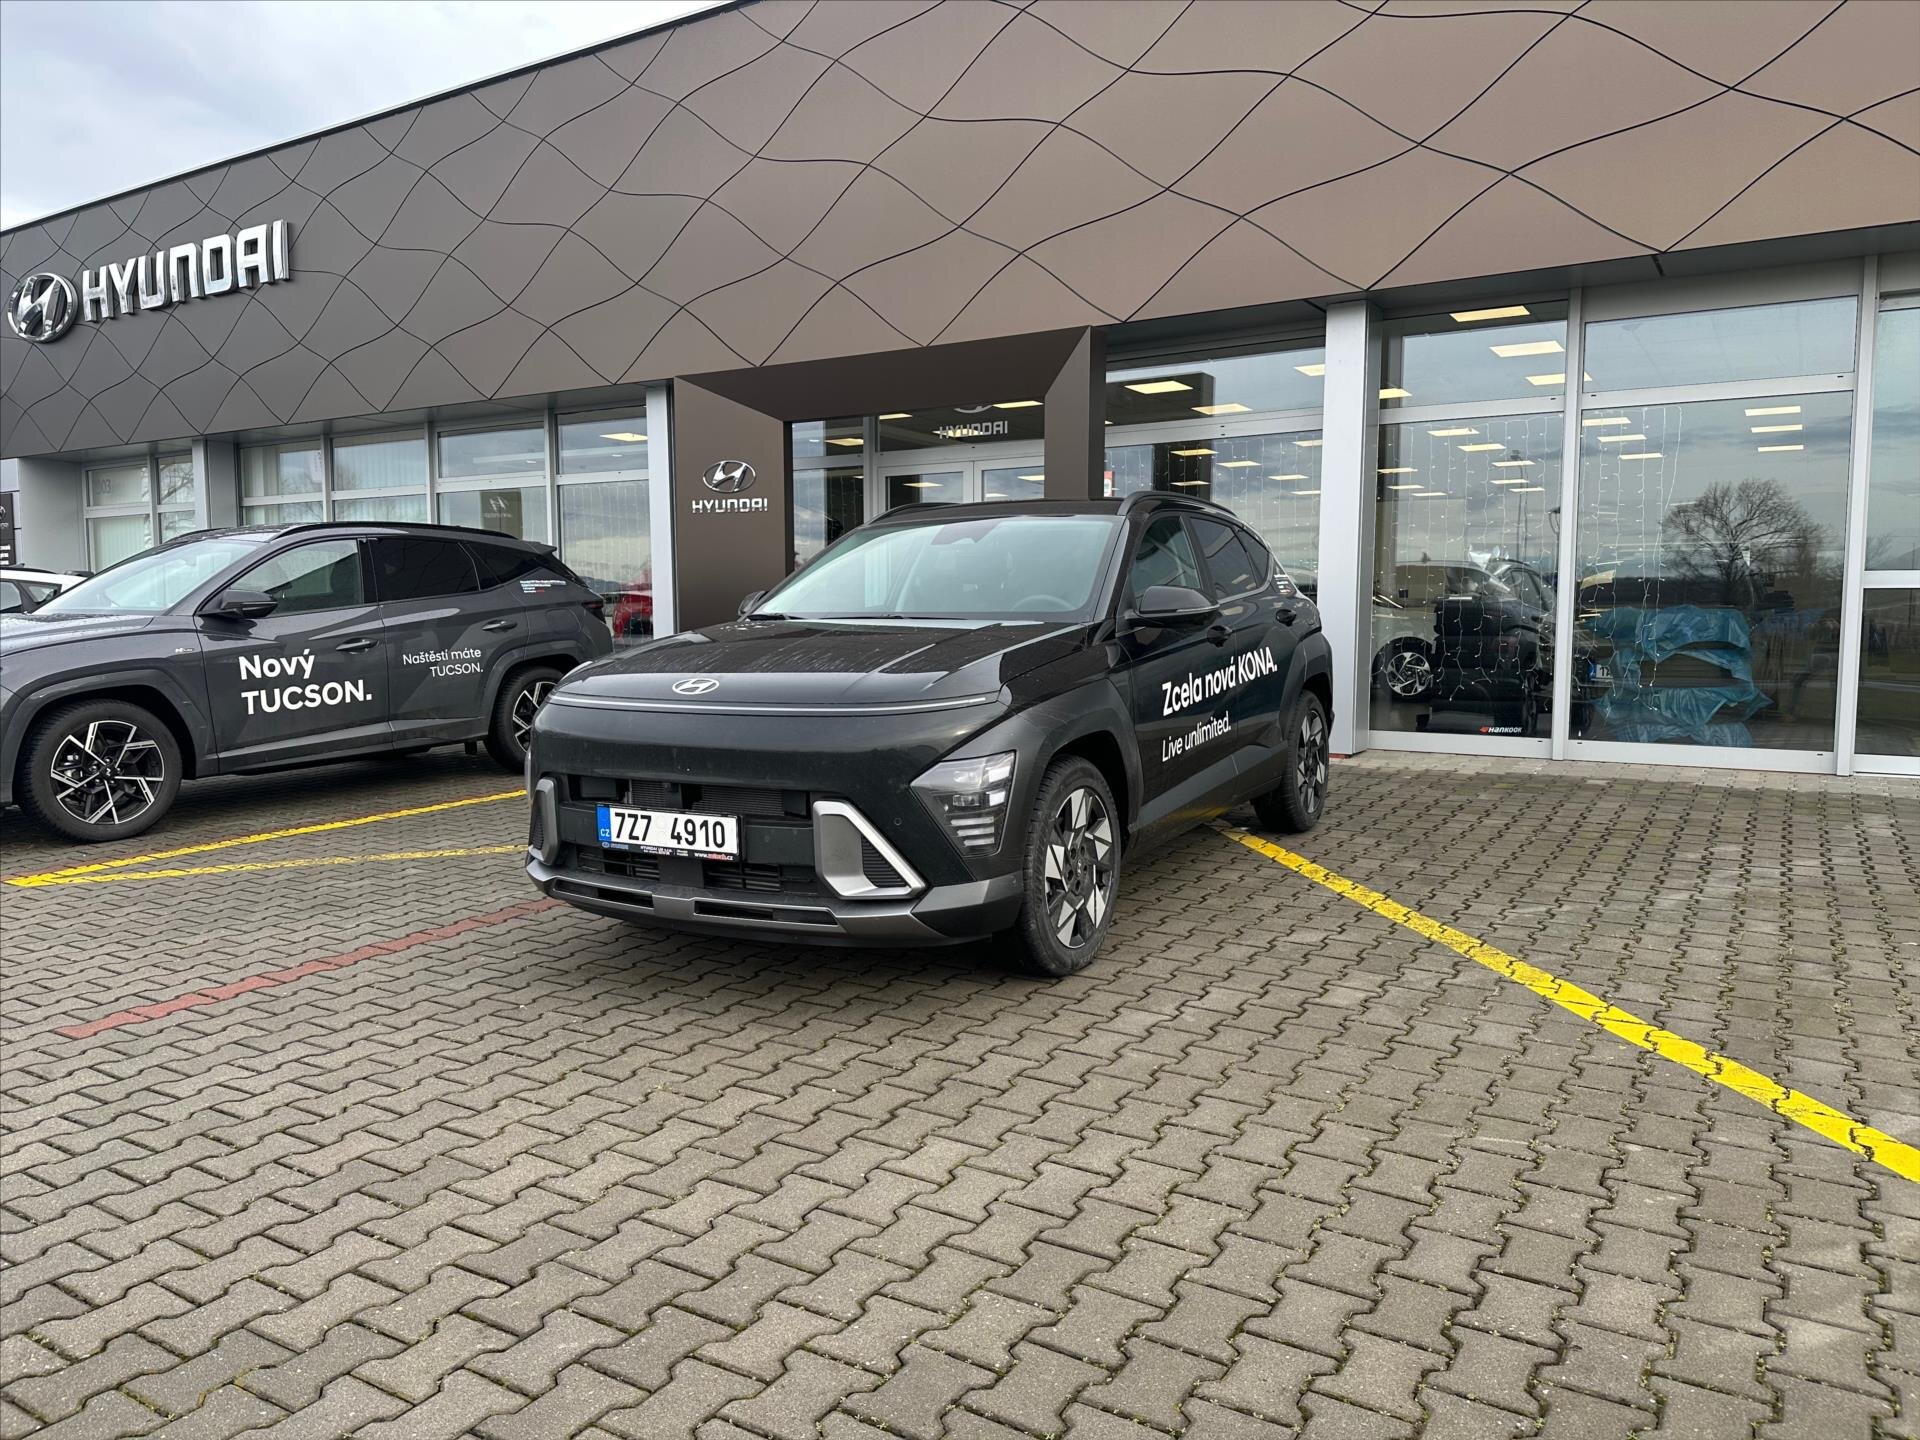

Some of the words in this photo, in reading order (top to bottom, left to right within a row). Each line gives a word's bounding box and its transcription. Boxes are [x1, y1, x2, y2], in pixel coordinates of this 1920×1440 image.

[82, 219, 289, 323] HYUNDAI
[939, 420, 1008, 439] HYUNDAI
[692, 498, 767, 513] HYUNDAI
[238, 648, 315, 680] Nový
[402, 648, 449, 665] Naštěstí
[450, 647, 482, 660] máte
[429, 662, 485, 678] TUCSON.
[240, 679, 373, 715] TUCSON.
[1161, 672, 1203, 717] Zcela
[1205, 655, 1236, 698] nová
[1238, 646, 1278, 685] KONA.
[1162, 735, 1183, 763] Live
[1184, 710, 1232, 751] unlimited.
[600, 828, 610, 837] CZ
[670, 817, 726, 849] 4910
